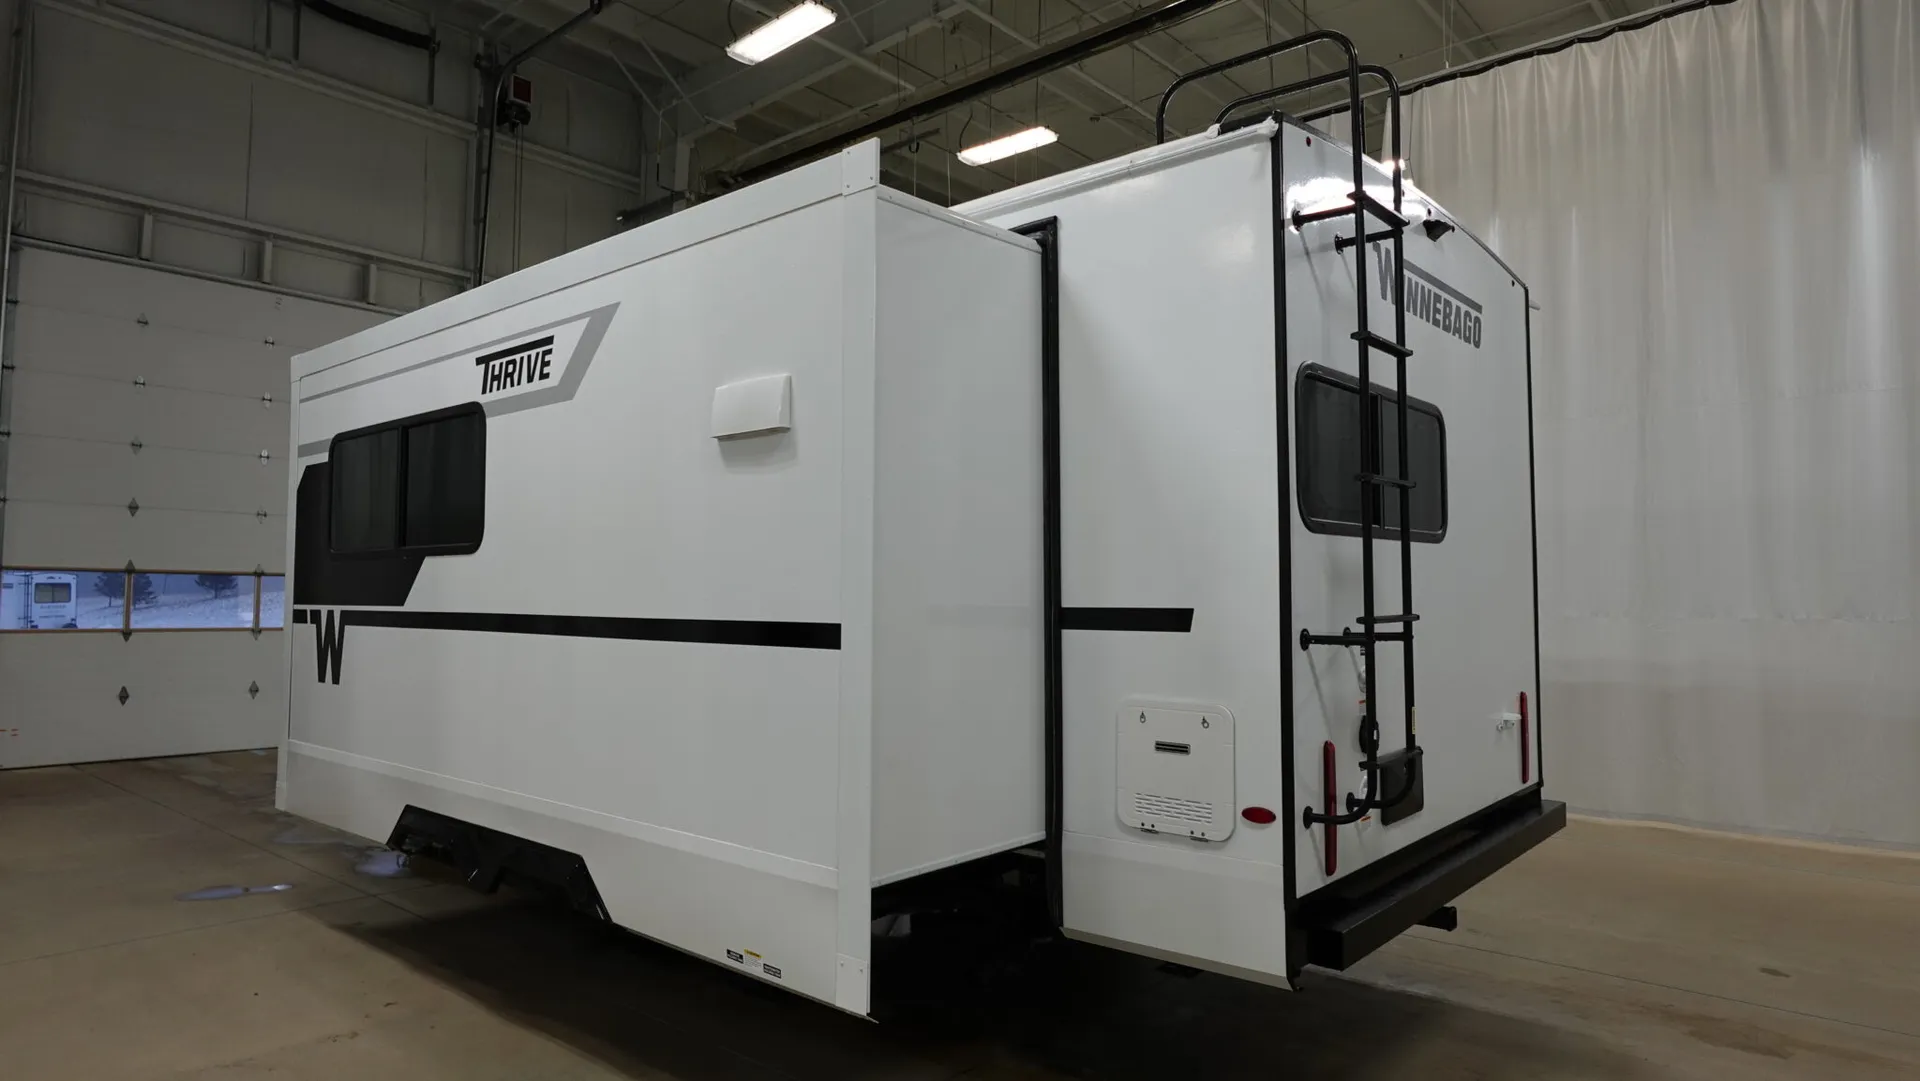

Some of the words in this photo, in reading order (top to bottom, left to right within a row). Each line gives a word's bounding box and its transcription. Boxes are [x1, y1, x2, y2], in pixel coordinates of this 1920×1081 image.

[1372, 241, 1483, 349] WNNEBAGO
[475, 334, 555, 395] THRIVE
[309, 609, 347, 686] W
